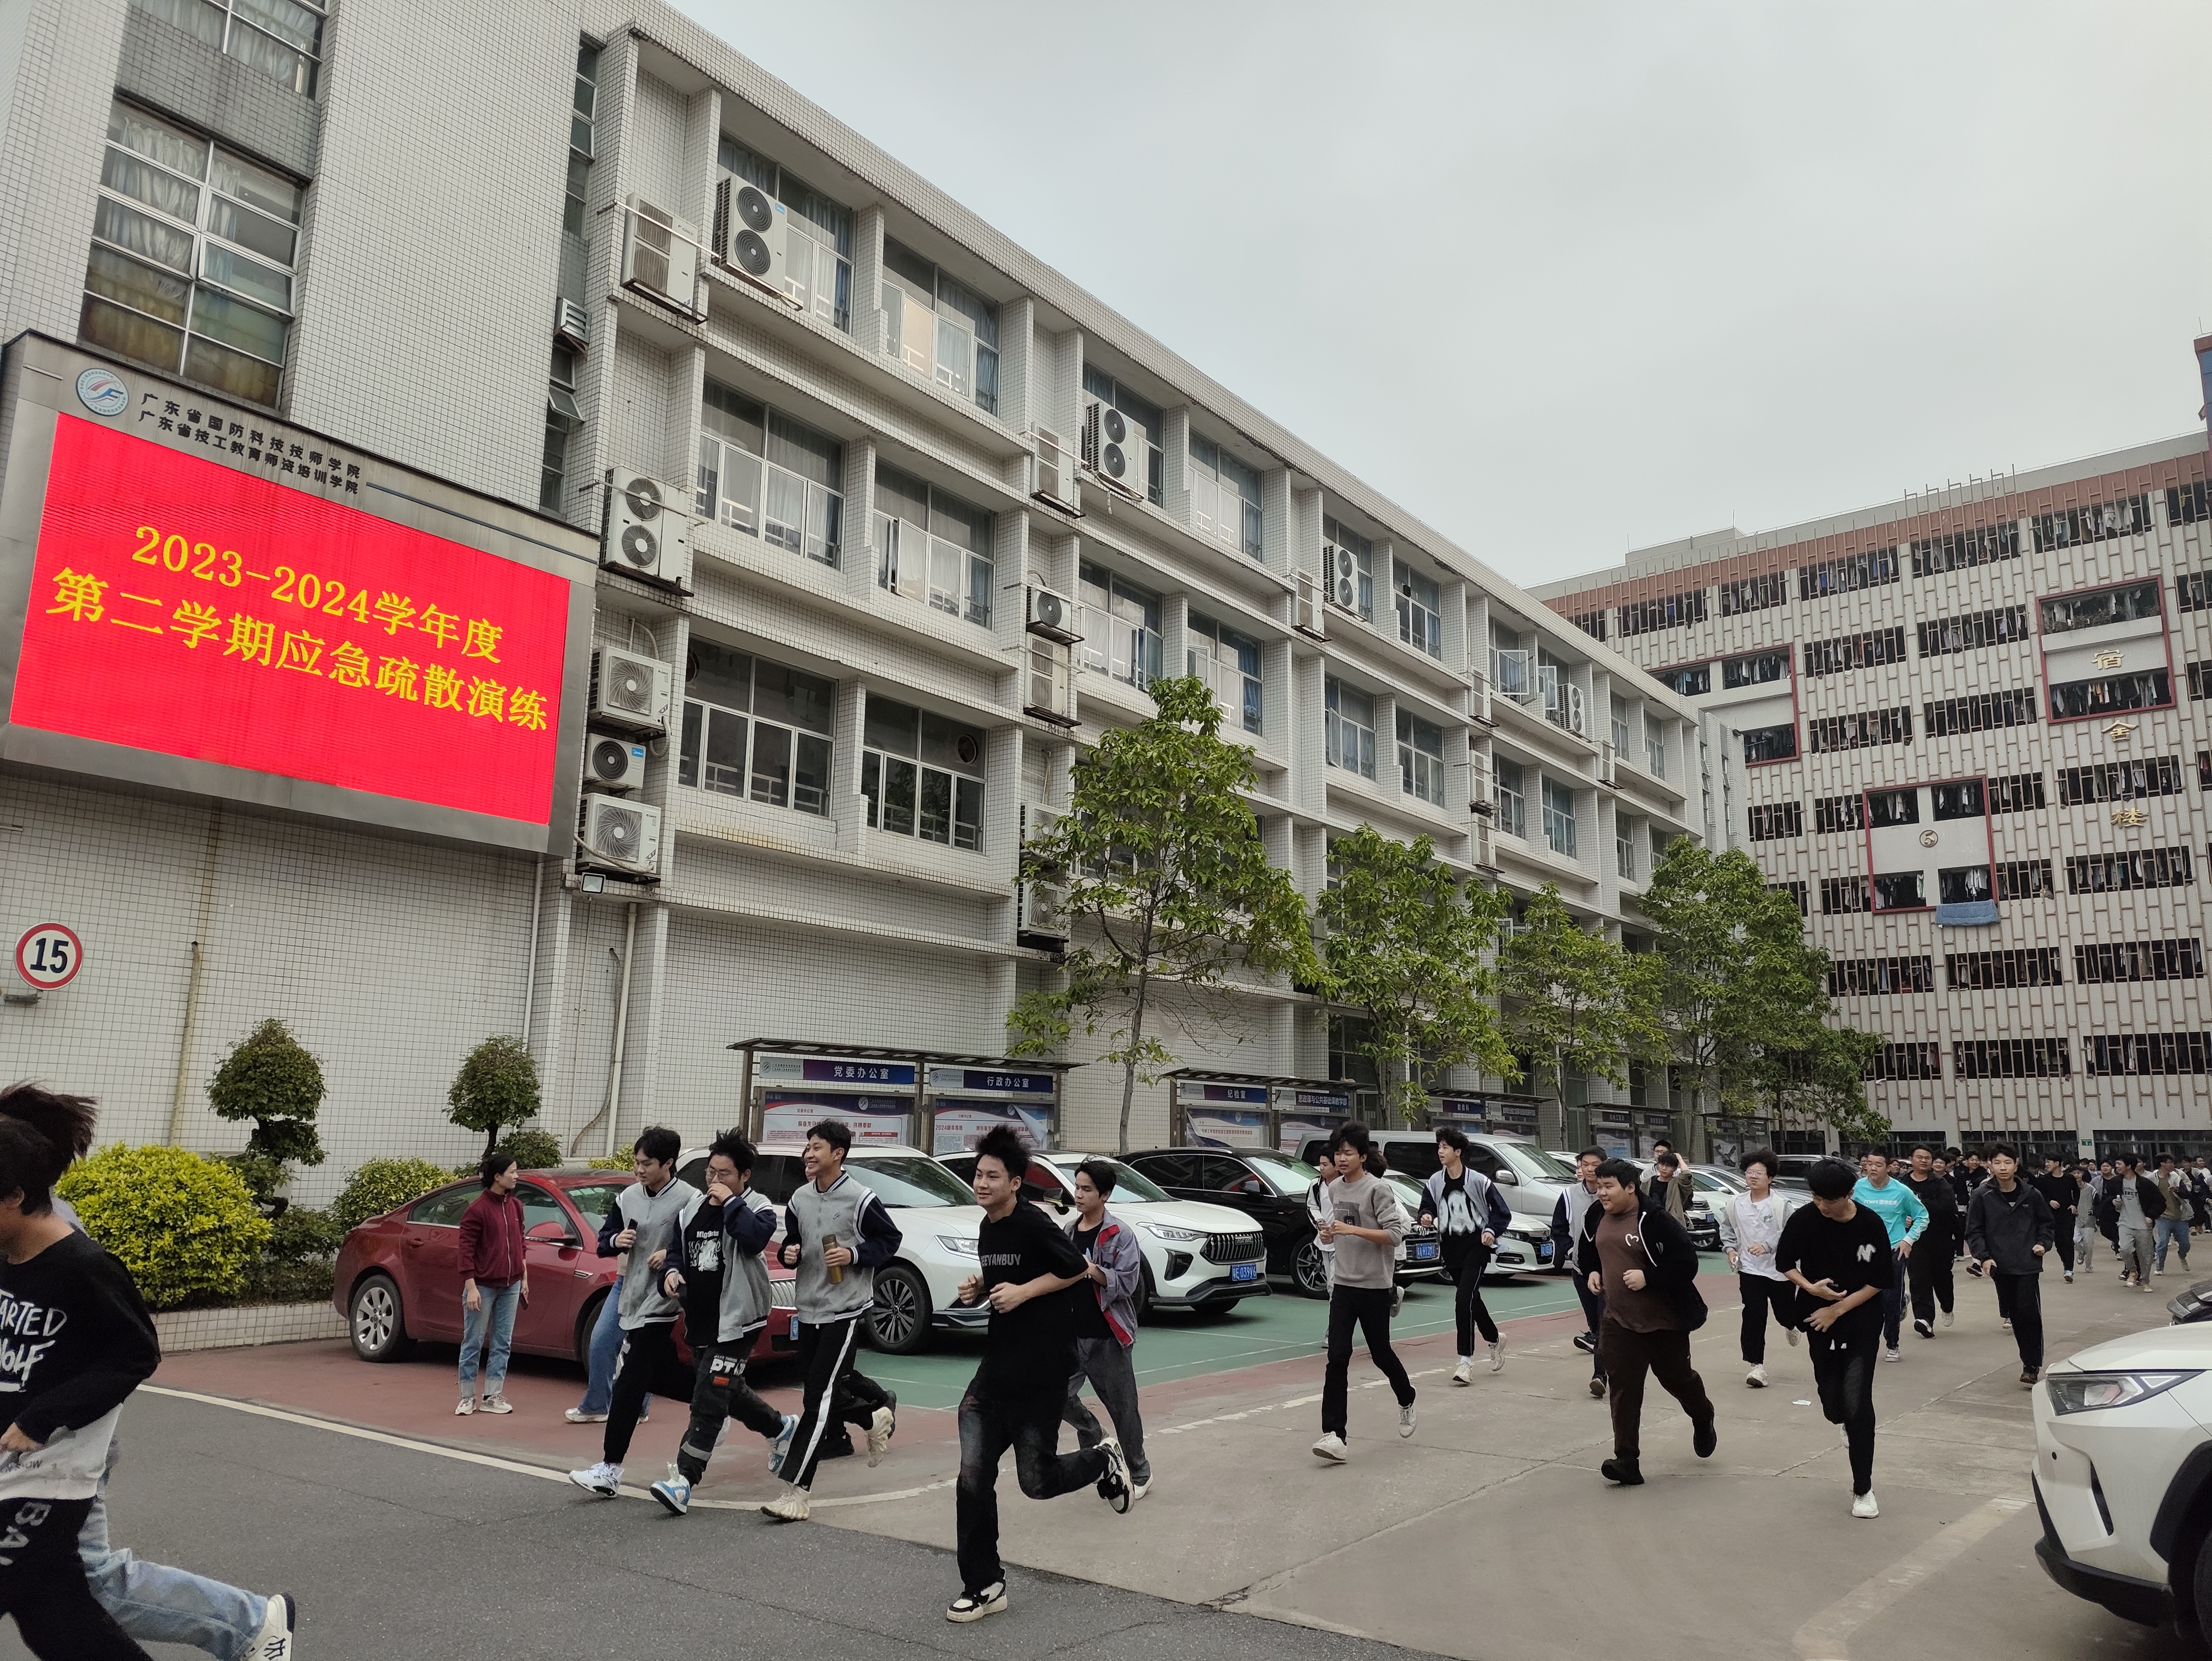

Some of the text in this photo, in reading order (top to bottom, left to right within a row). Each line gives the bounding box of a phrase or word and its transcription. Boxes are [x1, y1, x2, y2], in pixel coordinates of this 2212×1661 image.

[138, 410, 358, 495] 广东省技工教育师资培训学院
[141, 392, 360, 479] 广东省国防科技技师学院
[132, 526, 503, 663] 2023-2024学年度
[45, 567, 547, 731] 第二学期应急疏散演练
[30, 938, 69, 974] 15
[833, 1065, 889, 1079] 党委办公室
[986, 1076, 1029, 1088] 行政办公室
[1227, 1089, 1246, 1099] 纪检室
